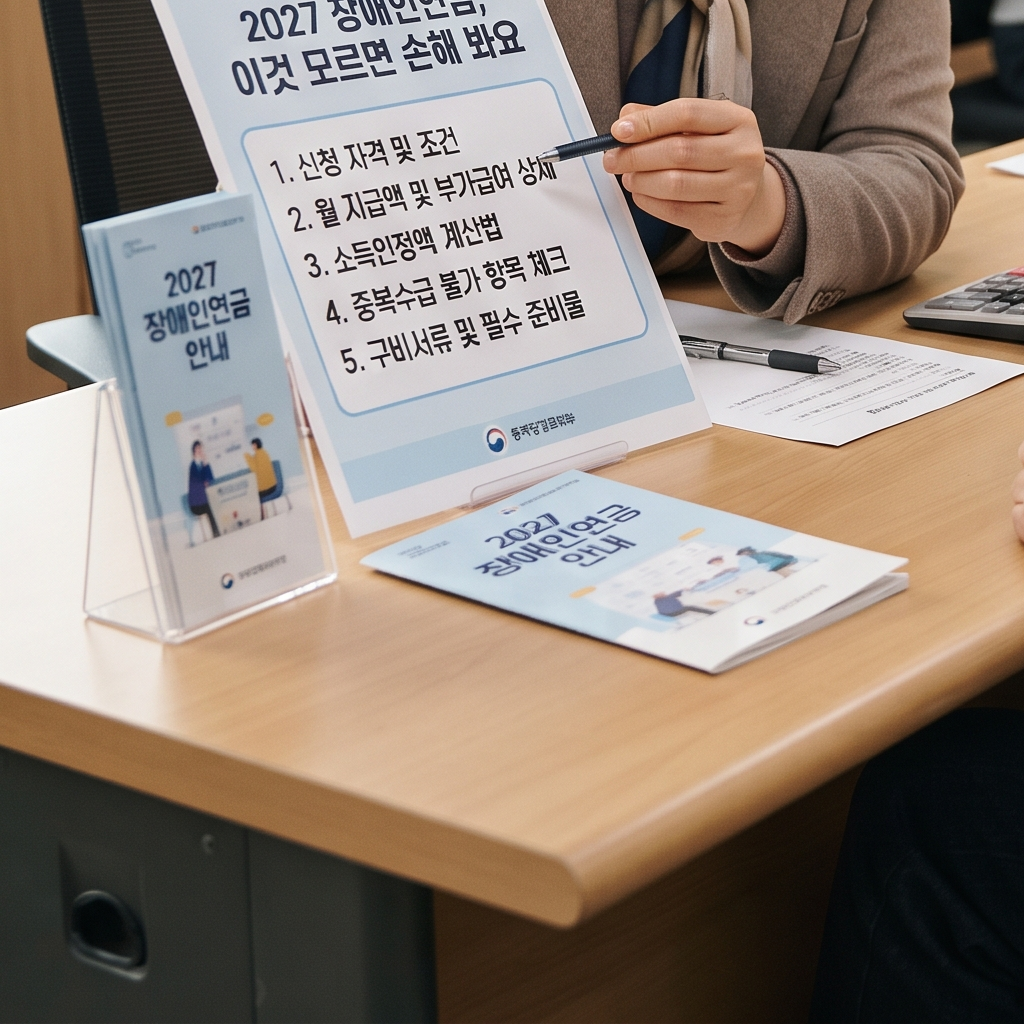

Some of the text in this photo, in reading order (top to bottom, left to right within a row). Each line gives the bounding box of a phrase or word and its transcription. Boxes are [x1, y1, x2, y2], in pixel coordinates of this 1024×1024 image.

[239, 0, 318, 43] 2027
[231, 20, 527, 96] 이것 모르면 손해 봐요
[269, 126, 461, 184] 1. 신청 자격 및 조건
[287, 206, 314, 233] 2.
[314, 197, 342, 229] 월
[340, 183, 409, 222] 지급액
[408, 178, 434, 210] 및
[433, 161, 515, 203] 부가급여
[303, 212, 504, 278] 3. 소득인정액 계산법
[164, 260, 217, 298] 2027
[325, 245, 571, 325] 4. 중복수급 불가 항목 체크
[143, 287, 252, 343] 장애인연금
[339, 289, 586, 374] 5. 구비서류 및 필수 준비물
[185, 330, 230, 371] 안내
[484, 512, 560, 549] 2027
[560, 534, 637, 567] 안내
